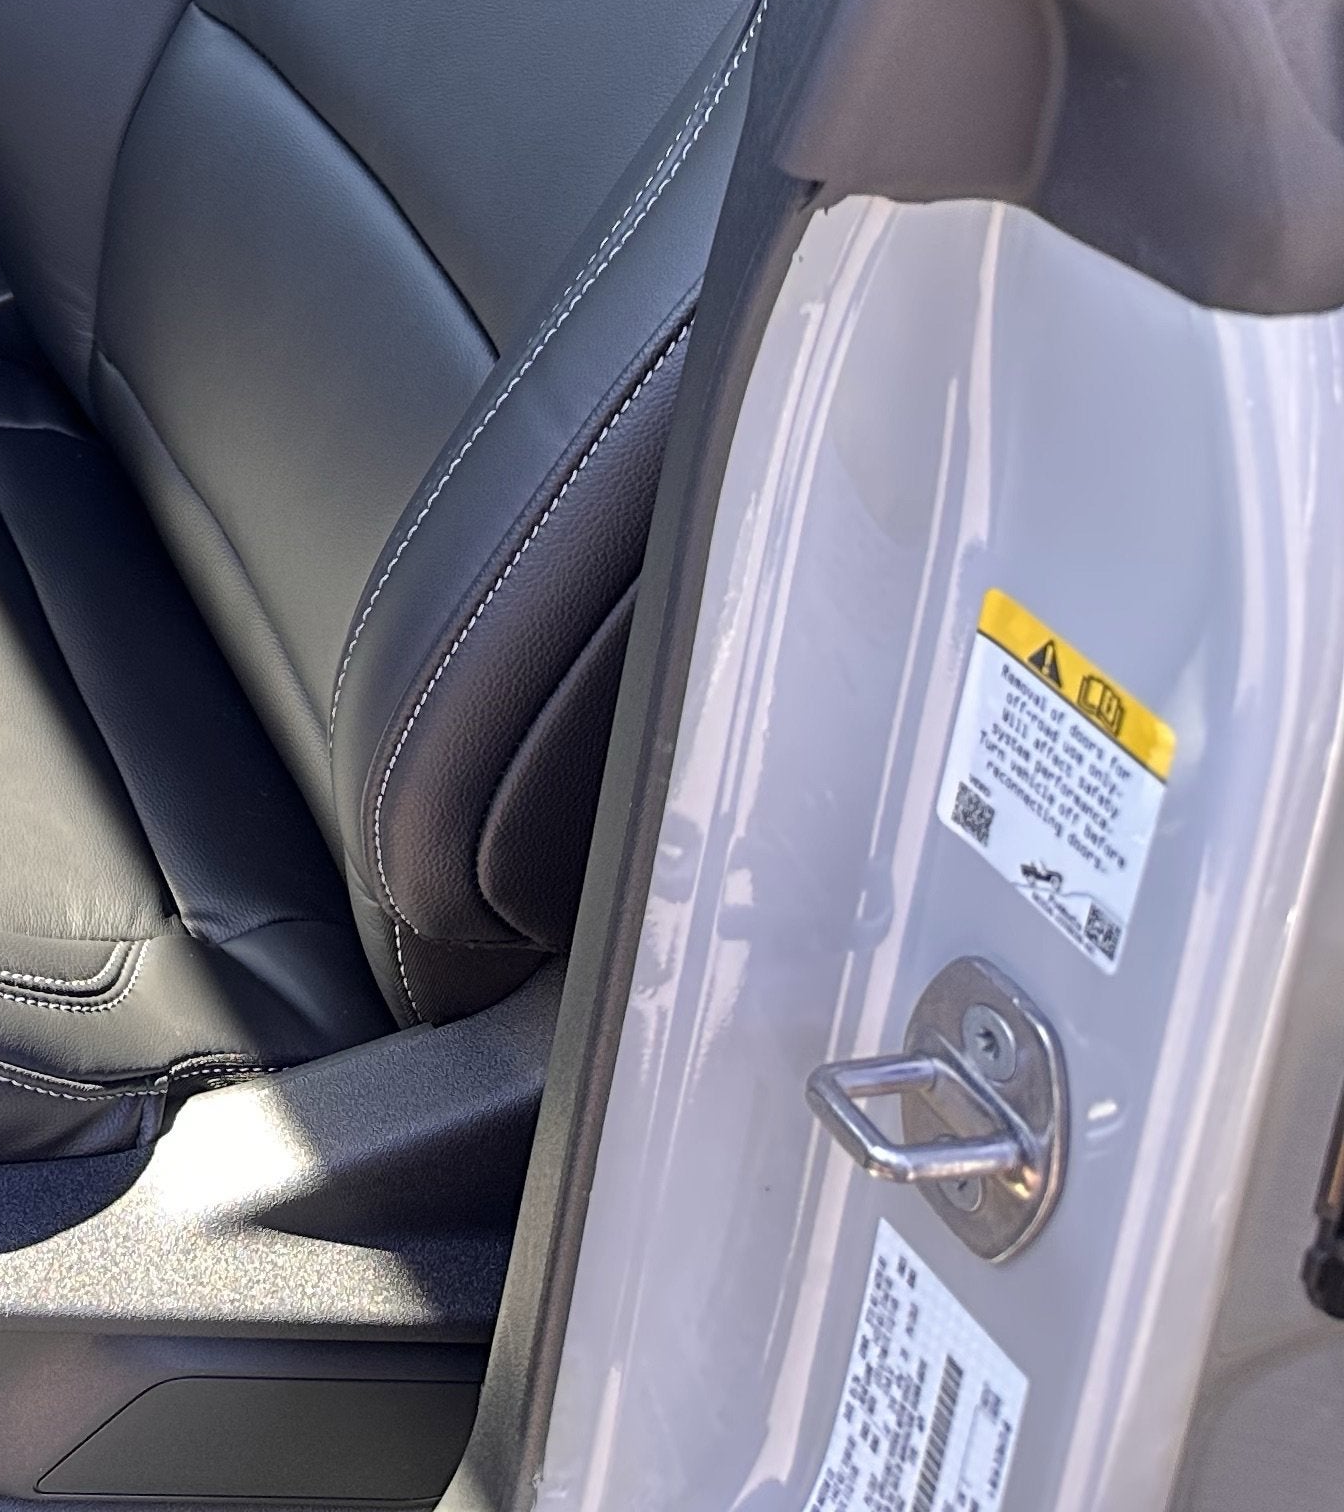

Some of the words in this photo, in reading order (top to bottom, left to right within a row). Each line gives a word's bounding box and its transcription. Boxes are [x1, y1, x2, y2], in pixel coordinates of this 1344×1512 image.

[992, 722, 1030, 762] system
[1001, 664, 1047, 712] Removal
[1050, 708, 1065, 723] of
[1069, 724, 1104, 760] doors
[1111, 756, 1131, 780] for
[1002, 707, 1029, 738] Will
[1033, 738, 1073, 778] affect
[1078, 776, 1119, 820] safety
[1063, 741, 1084, 765] use
[980, 730, 1006, 761] Turn
[1010, 760, 1055, 806] vehicle
[1058, 803, 1081, 826] off
[1084, 823, 1127, 869] before
[986, 760, 1062, 838] reconnecting
